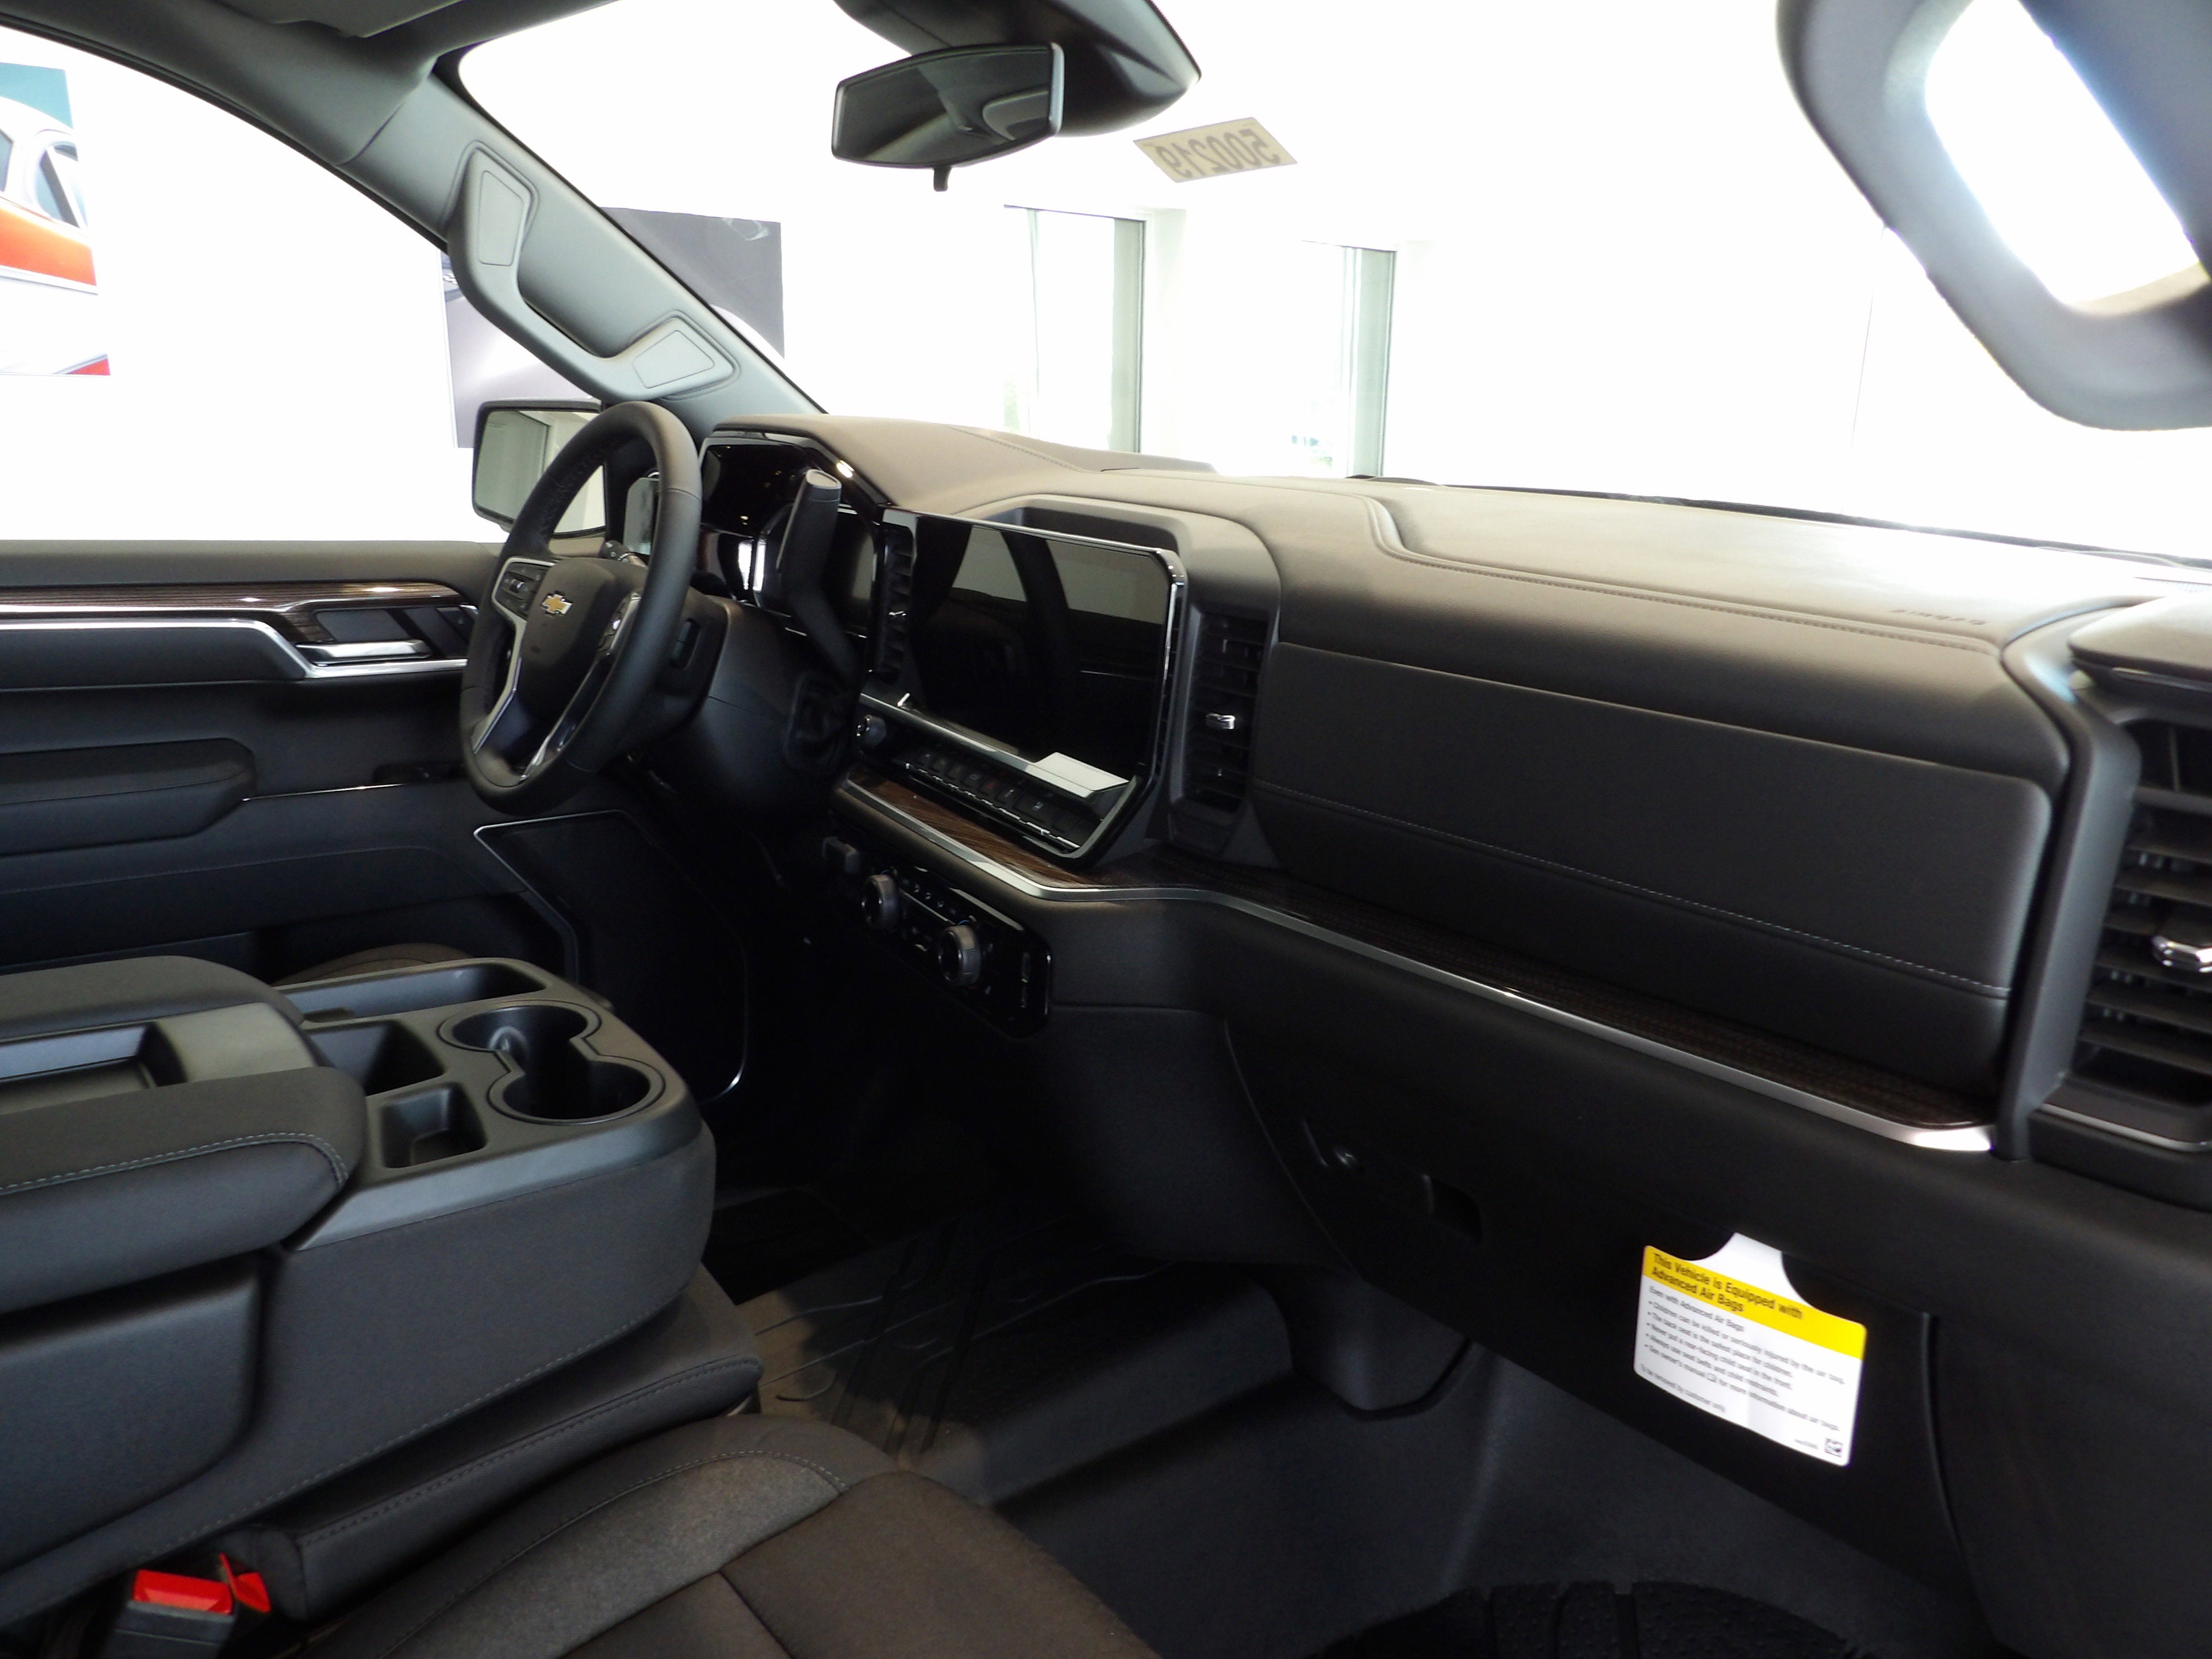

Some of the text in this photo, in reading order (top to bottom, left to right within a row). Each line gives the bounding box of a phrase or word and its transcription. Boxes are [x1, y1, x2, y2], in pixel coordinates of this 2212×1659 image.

[1652, 1267, 1743, 1311] Advanced Air Bags
[1655, 1253, 1802, 1319] This Vehicle is Equipped with
